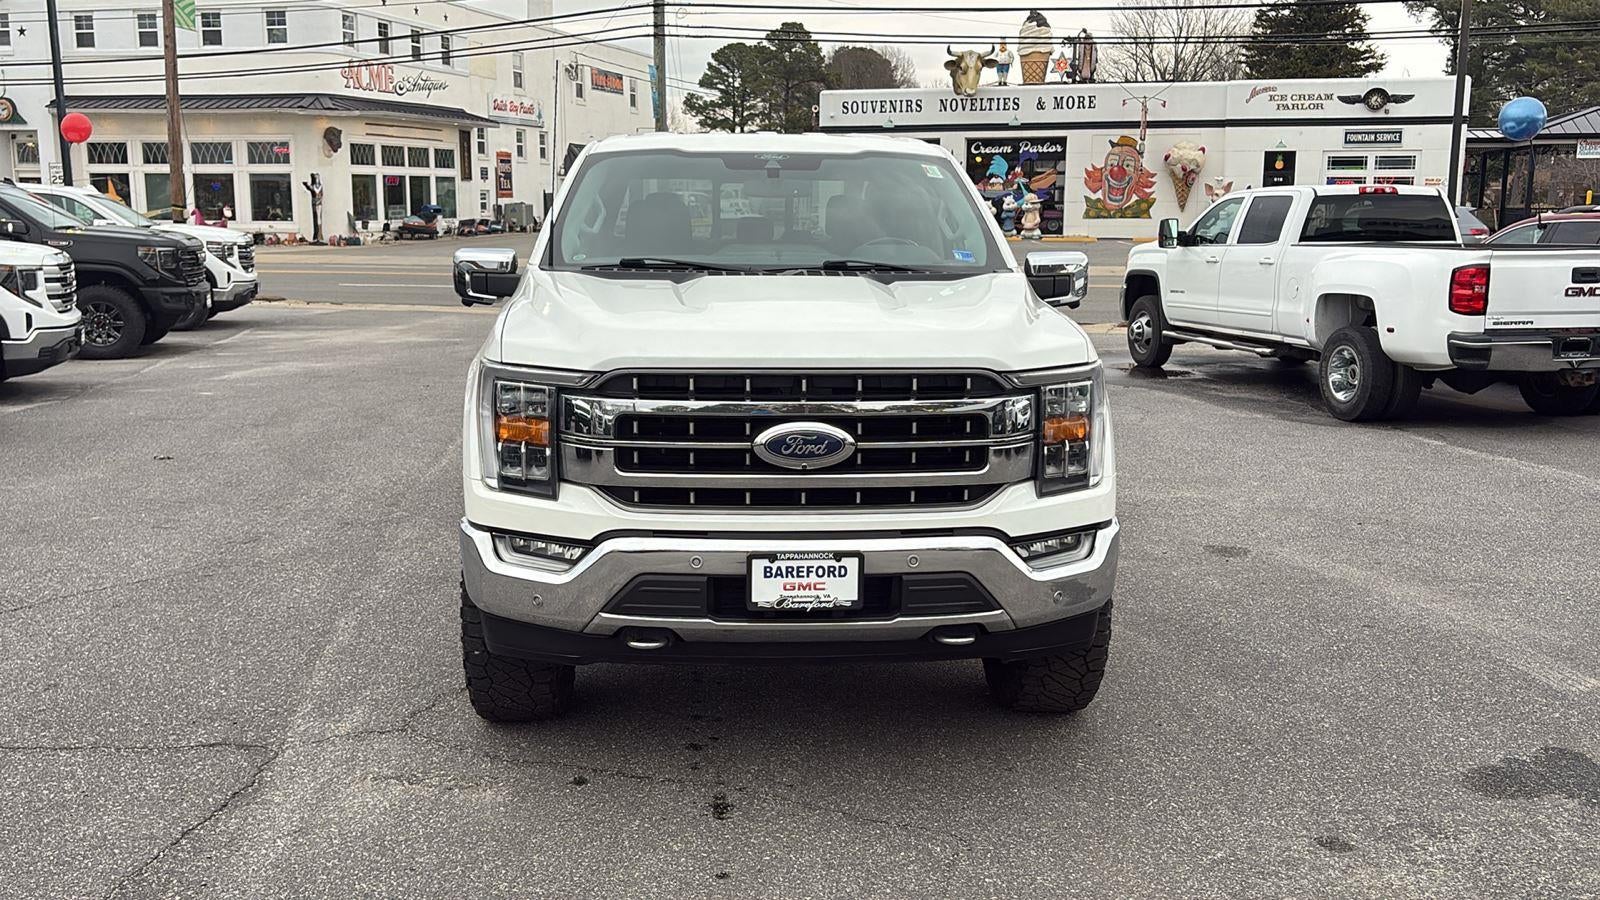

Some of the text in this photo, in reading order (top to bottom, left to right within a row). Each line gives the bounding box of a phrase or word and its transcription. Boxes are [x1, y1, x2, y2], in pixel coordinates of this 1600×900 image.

[340, 59, 449, 98] ACME Antiques
[1269, 94, 1286, 102] ICE
[1290, 93, 1334, 102] CREAM
[509, 100, 518, 116] Boy
[841, 95, 1097, 115] SOUVENIRS NOVELTIES & MORE
[1276, 102, 1324, 110] PARLOR
[1347, 132, 1400, 142] FOUNTAIN SERVICE
[971, 140, 1065, 154] Cream Parlor
[52, 175, 64, 185] 25
[781, 435, 828, 455] Ford
[763, 565, 848, 578] BAREFORD
[782, 581, 827, 591] GMC
[773, 597, 838, 612] Bareford
